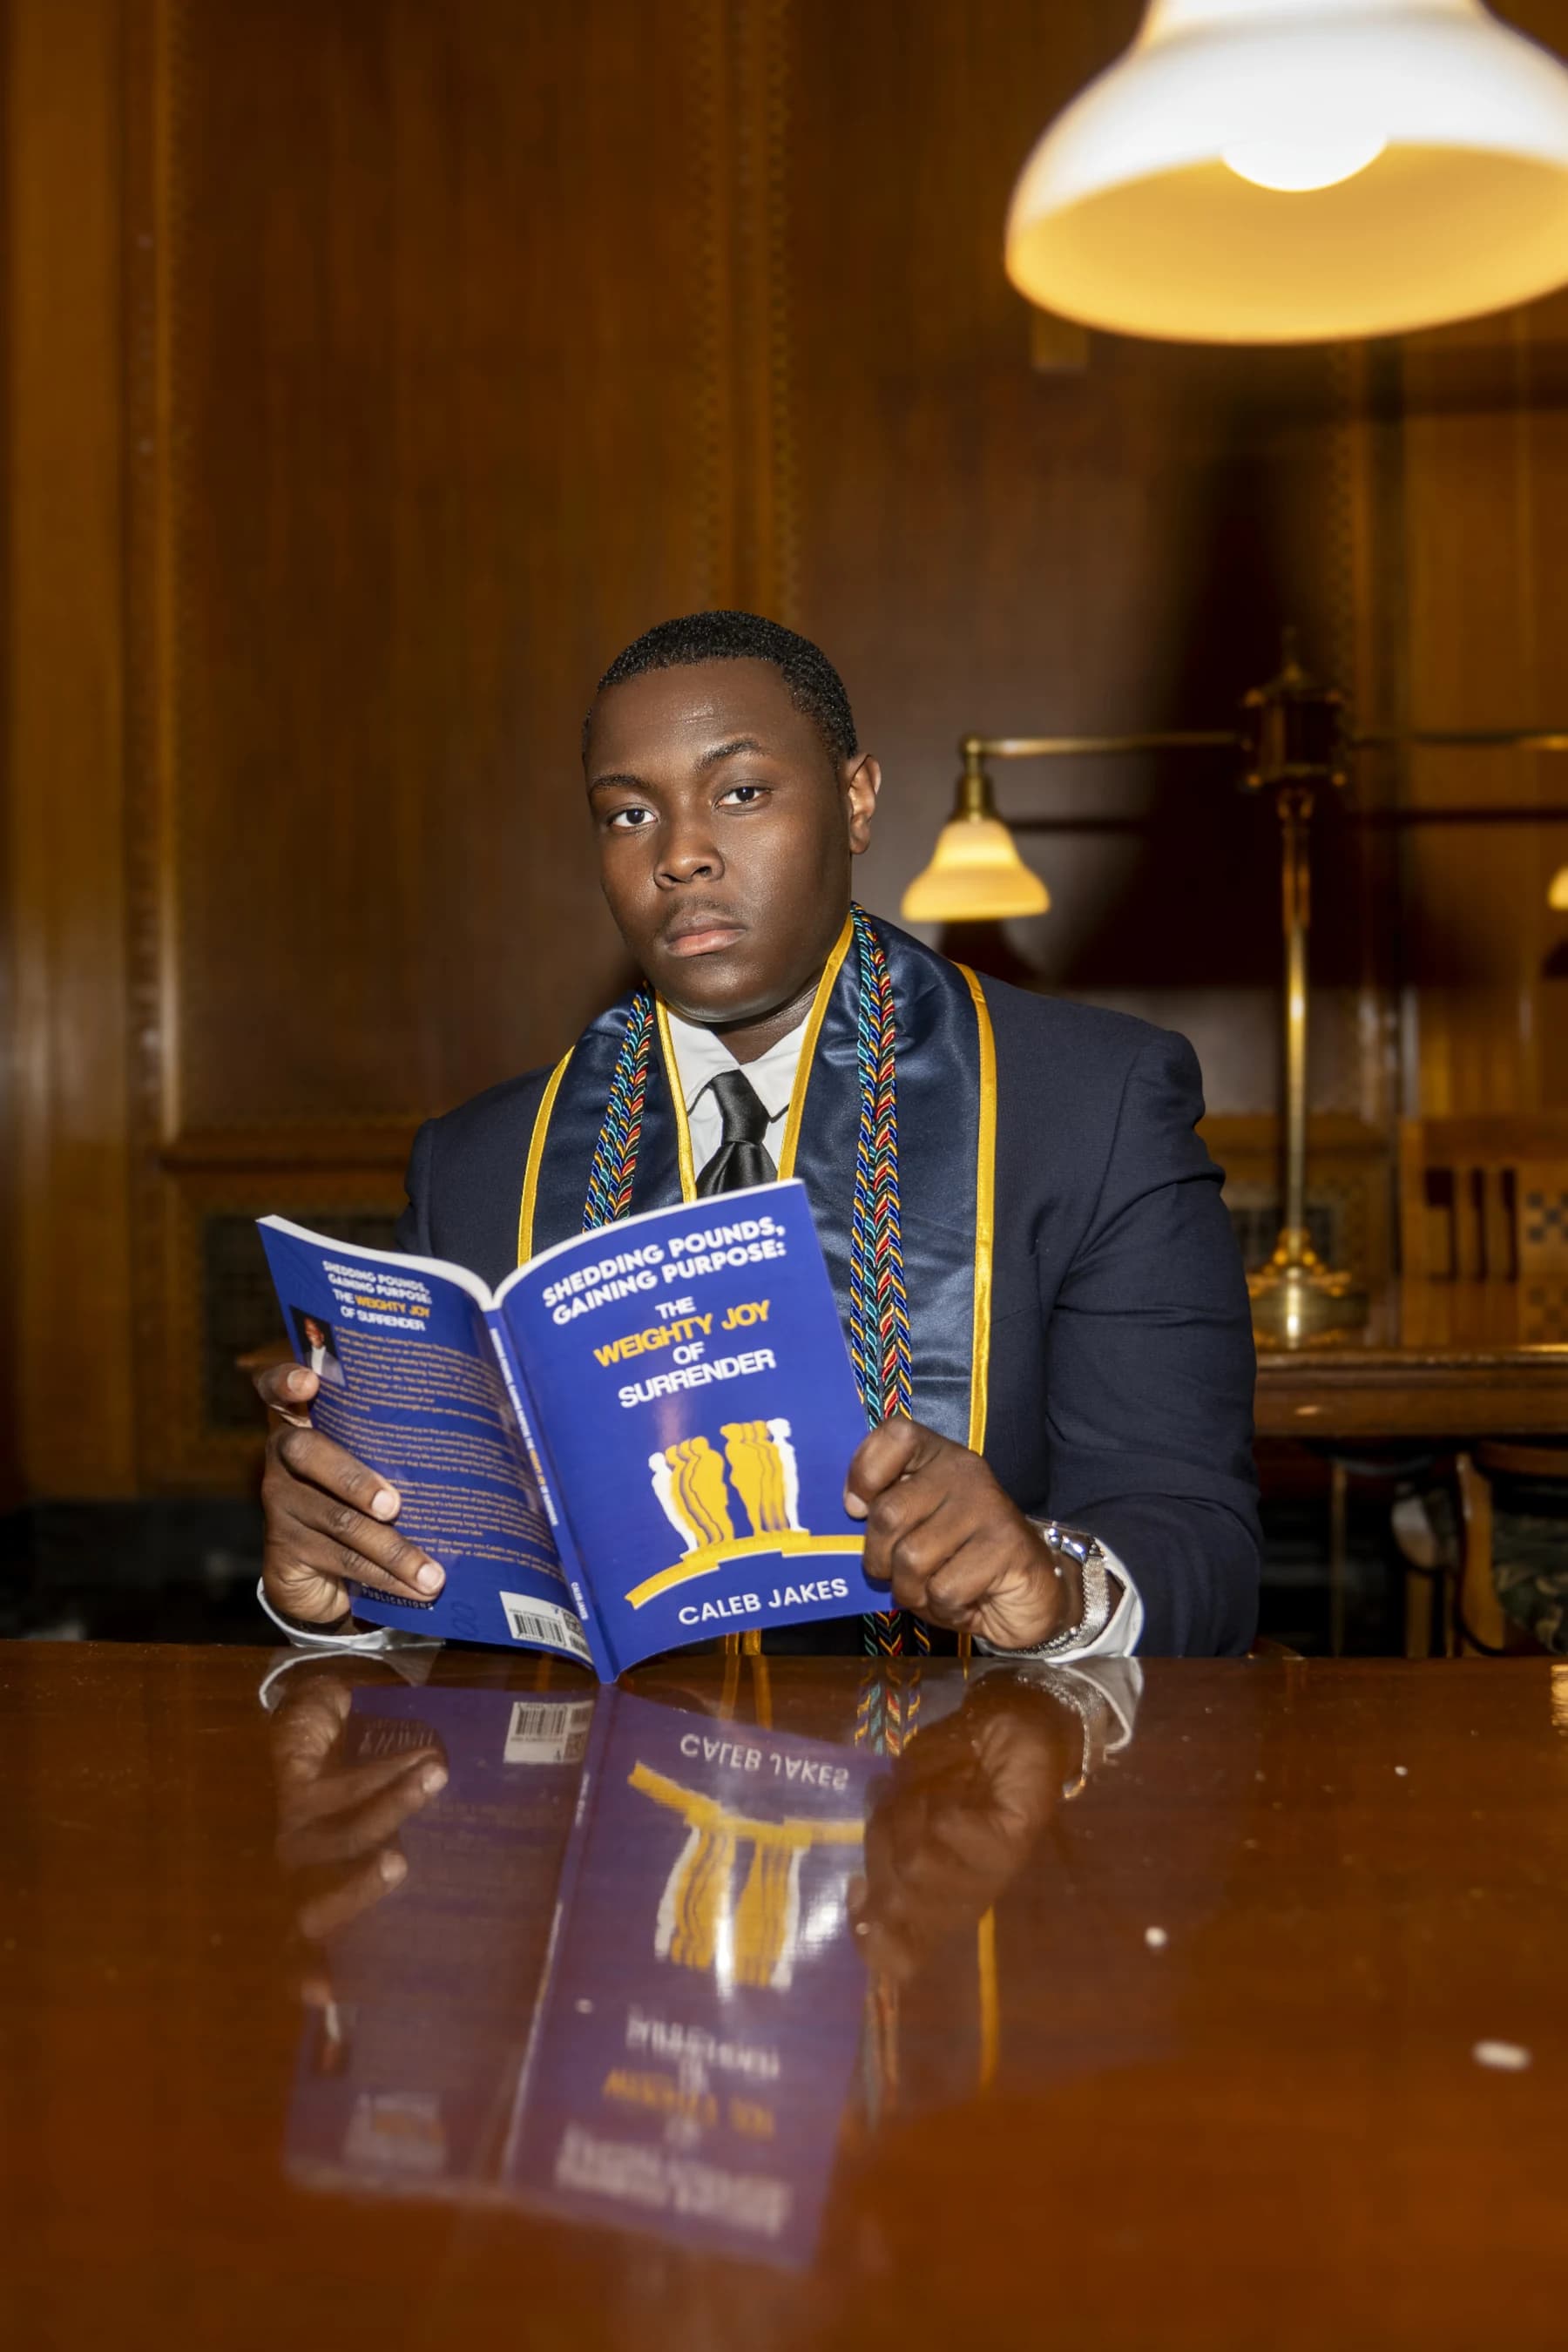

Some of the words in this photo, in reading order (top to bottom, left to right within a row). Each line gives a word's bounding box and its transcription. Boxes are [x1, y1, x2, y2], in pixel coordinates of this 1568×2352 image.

[542, 1243, 666, 1308] SHEDDING
[670, 1215, 786, 1259] POUNDS,
[551, 1270, 659, 1326] GAINING
[662, 1240, 787, 1289] PURPOSE:
[332, 1288, 355, 1305] THE
[355, 1294, 407, 1314] WEIGHTY
[409, 1305, 430, 1318] JOY
[340, 1306, 356, 1319] OF
[356, 1309, 427, 1332] SURRENDER
[655, 1296, 697, 1321] THE
[592, 1314, 713, 1368] WEIGHTY
[720, 1299, 772, 1333] JOY
[672, 1345, 706, 1366] OF
[618, 1348, 777, 1409] SURRENDER
[677, 1592, 762, 1626] CALEB
[767, 1577, 849, 1608] JAKES
